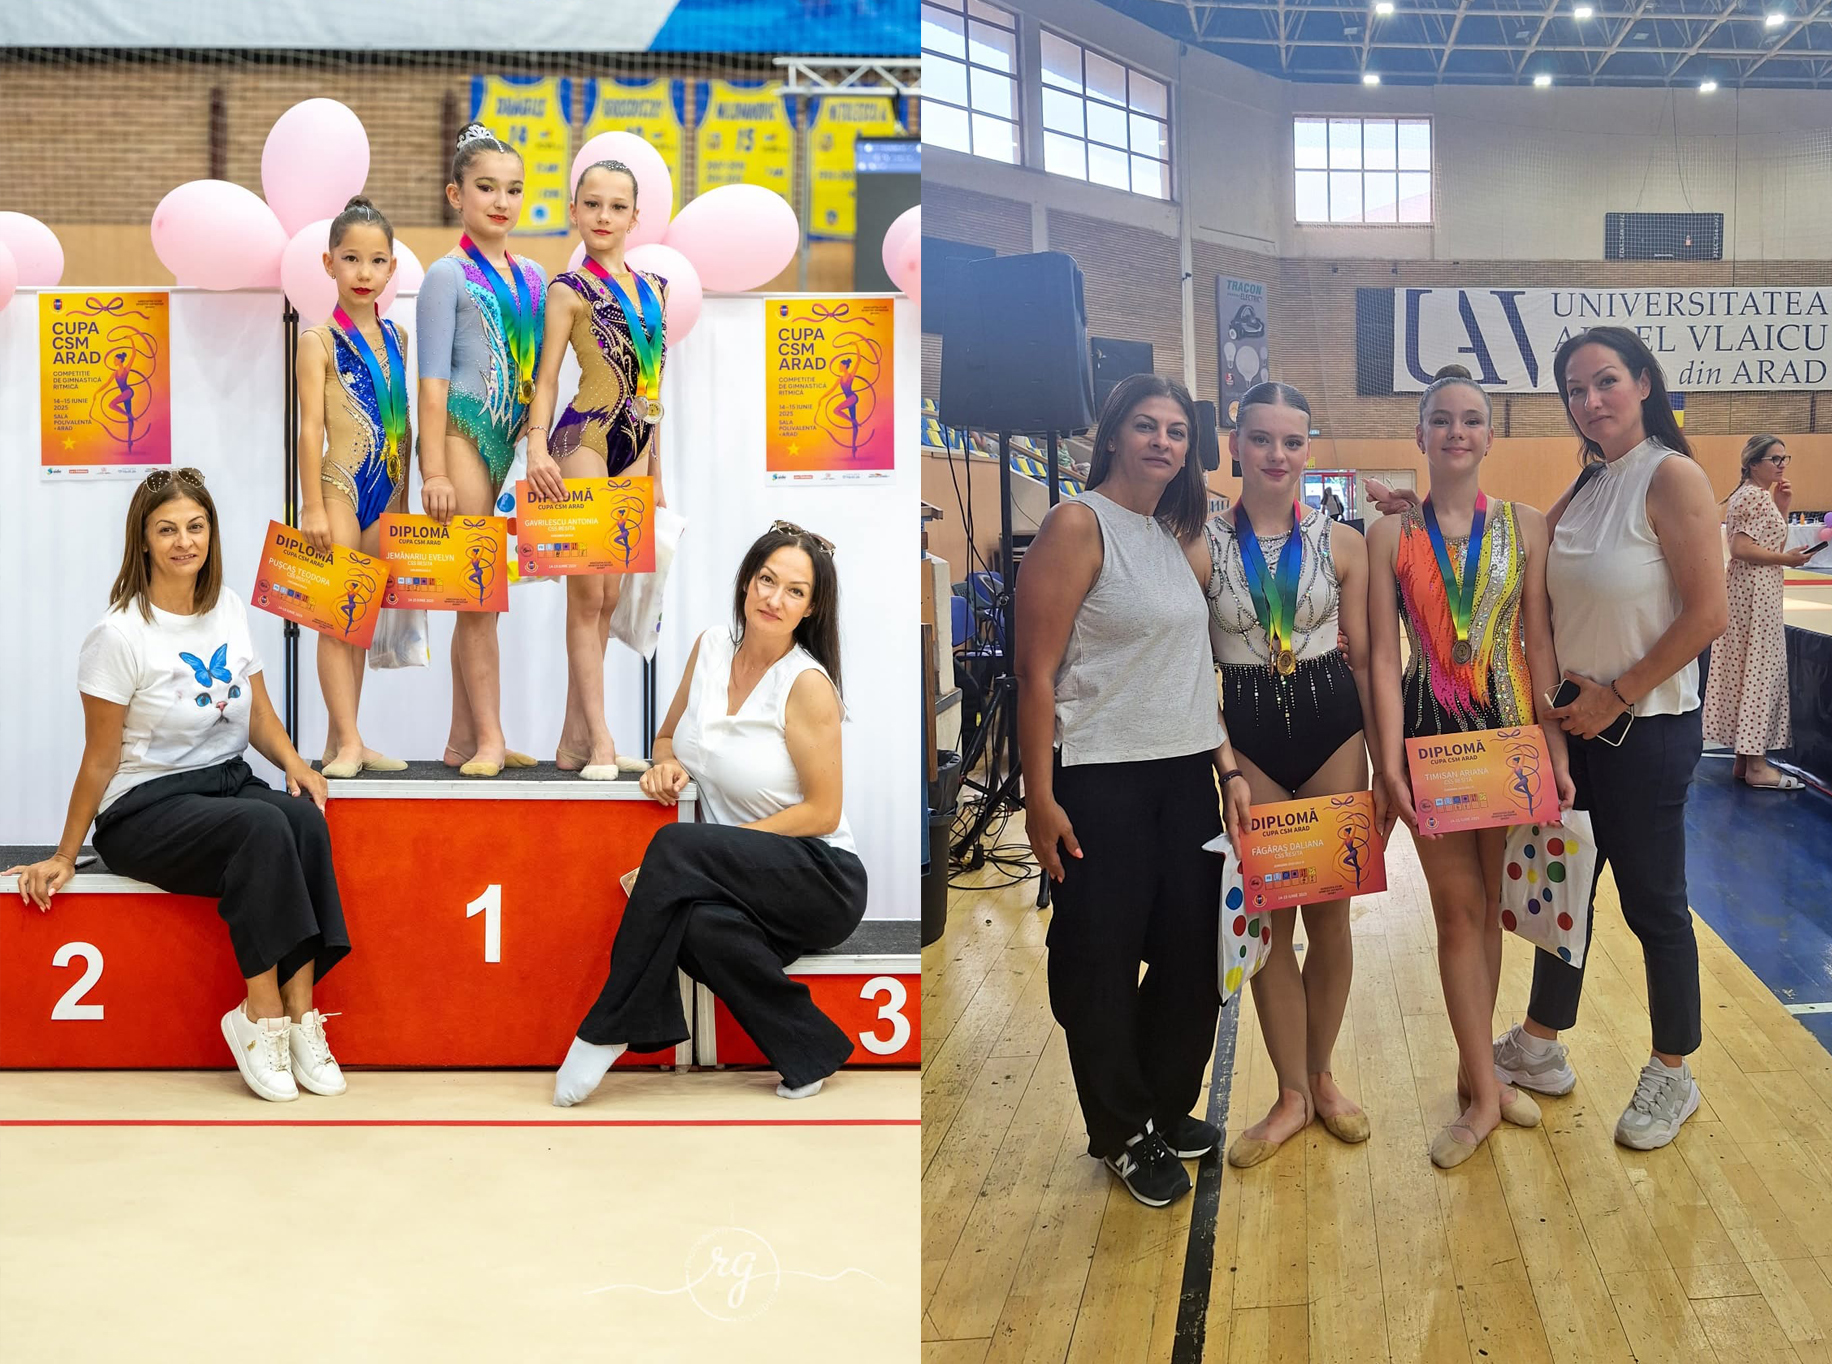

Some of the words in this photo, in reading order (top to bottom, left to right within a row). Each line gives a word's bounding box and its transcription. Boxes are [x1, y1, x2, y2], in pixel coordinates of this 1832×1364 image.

[1227, 280, 1262, 295] TRACON
[1552, 292, 1829, 318] UNIVERSITATEA
[52, 322, 99, 335] CUPA
[778, 328, 825, 341] CUPA
[52, 336, 89, 350] CSM
[1552, 324, 1676, 353] AEL
[1692, 324, 1827, 352] VLAICU
[778, 342, 814, 356] CSM
[53, 351, 101, 364] ARAD
[778, 357, 826, 371] ARAD
[1679, 360, 1722, 385] din
[1730, 360, 1827, 384] ARAD
[390, 523, 450, 538] DIPLOMĂ
[275, 534, 334, 565] DIPLOMĂ
[429, 553, 454, 562] EVELYN
[283, 549, 297, 558] CUPA
[298, 554, 309, 563] CSM
[310, 558, 324, 568] ARAD
[298, 568, 330, 586] TEODORA
[1418, 740, 1486, 760] DIPLOMĂ
[1459, 767, 1489, 776] ARIANA
[1251, 807, 1318, 831] DIPLOMĂ
[1290, 839, 1324, 851] DALIANA
[466, 884, 502, 962] 1
[51, 942, 104, 1020] 2
[858, 976, 911, 1055] 3
